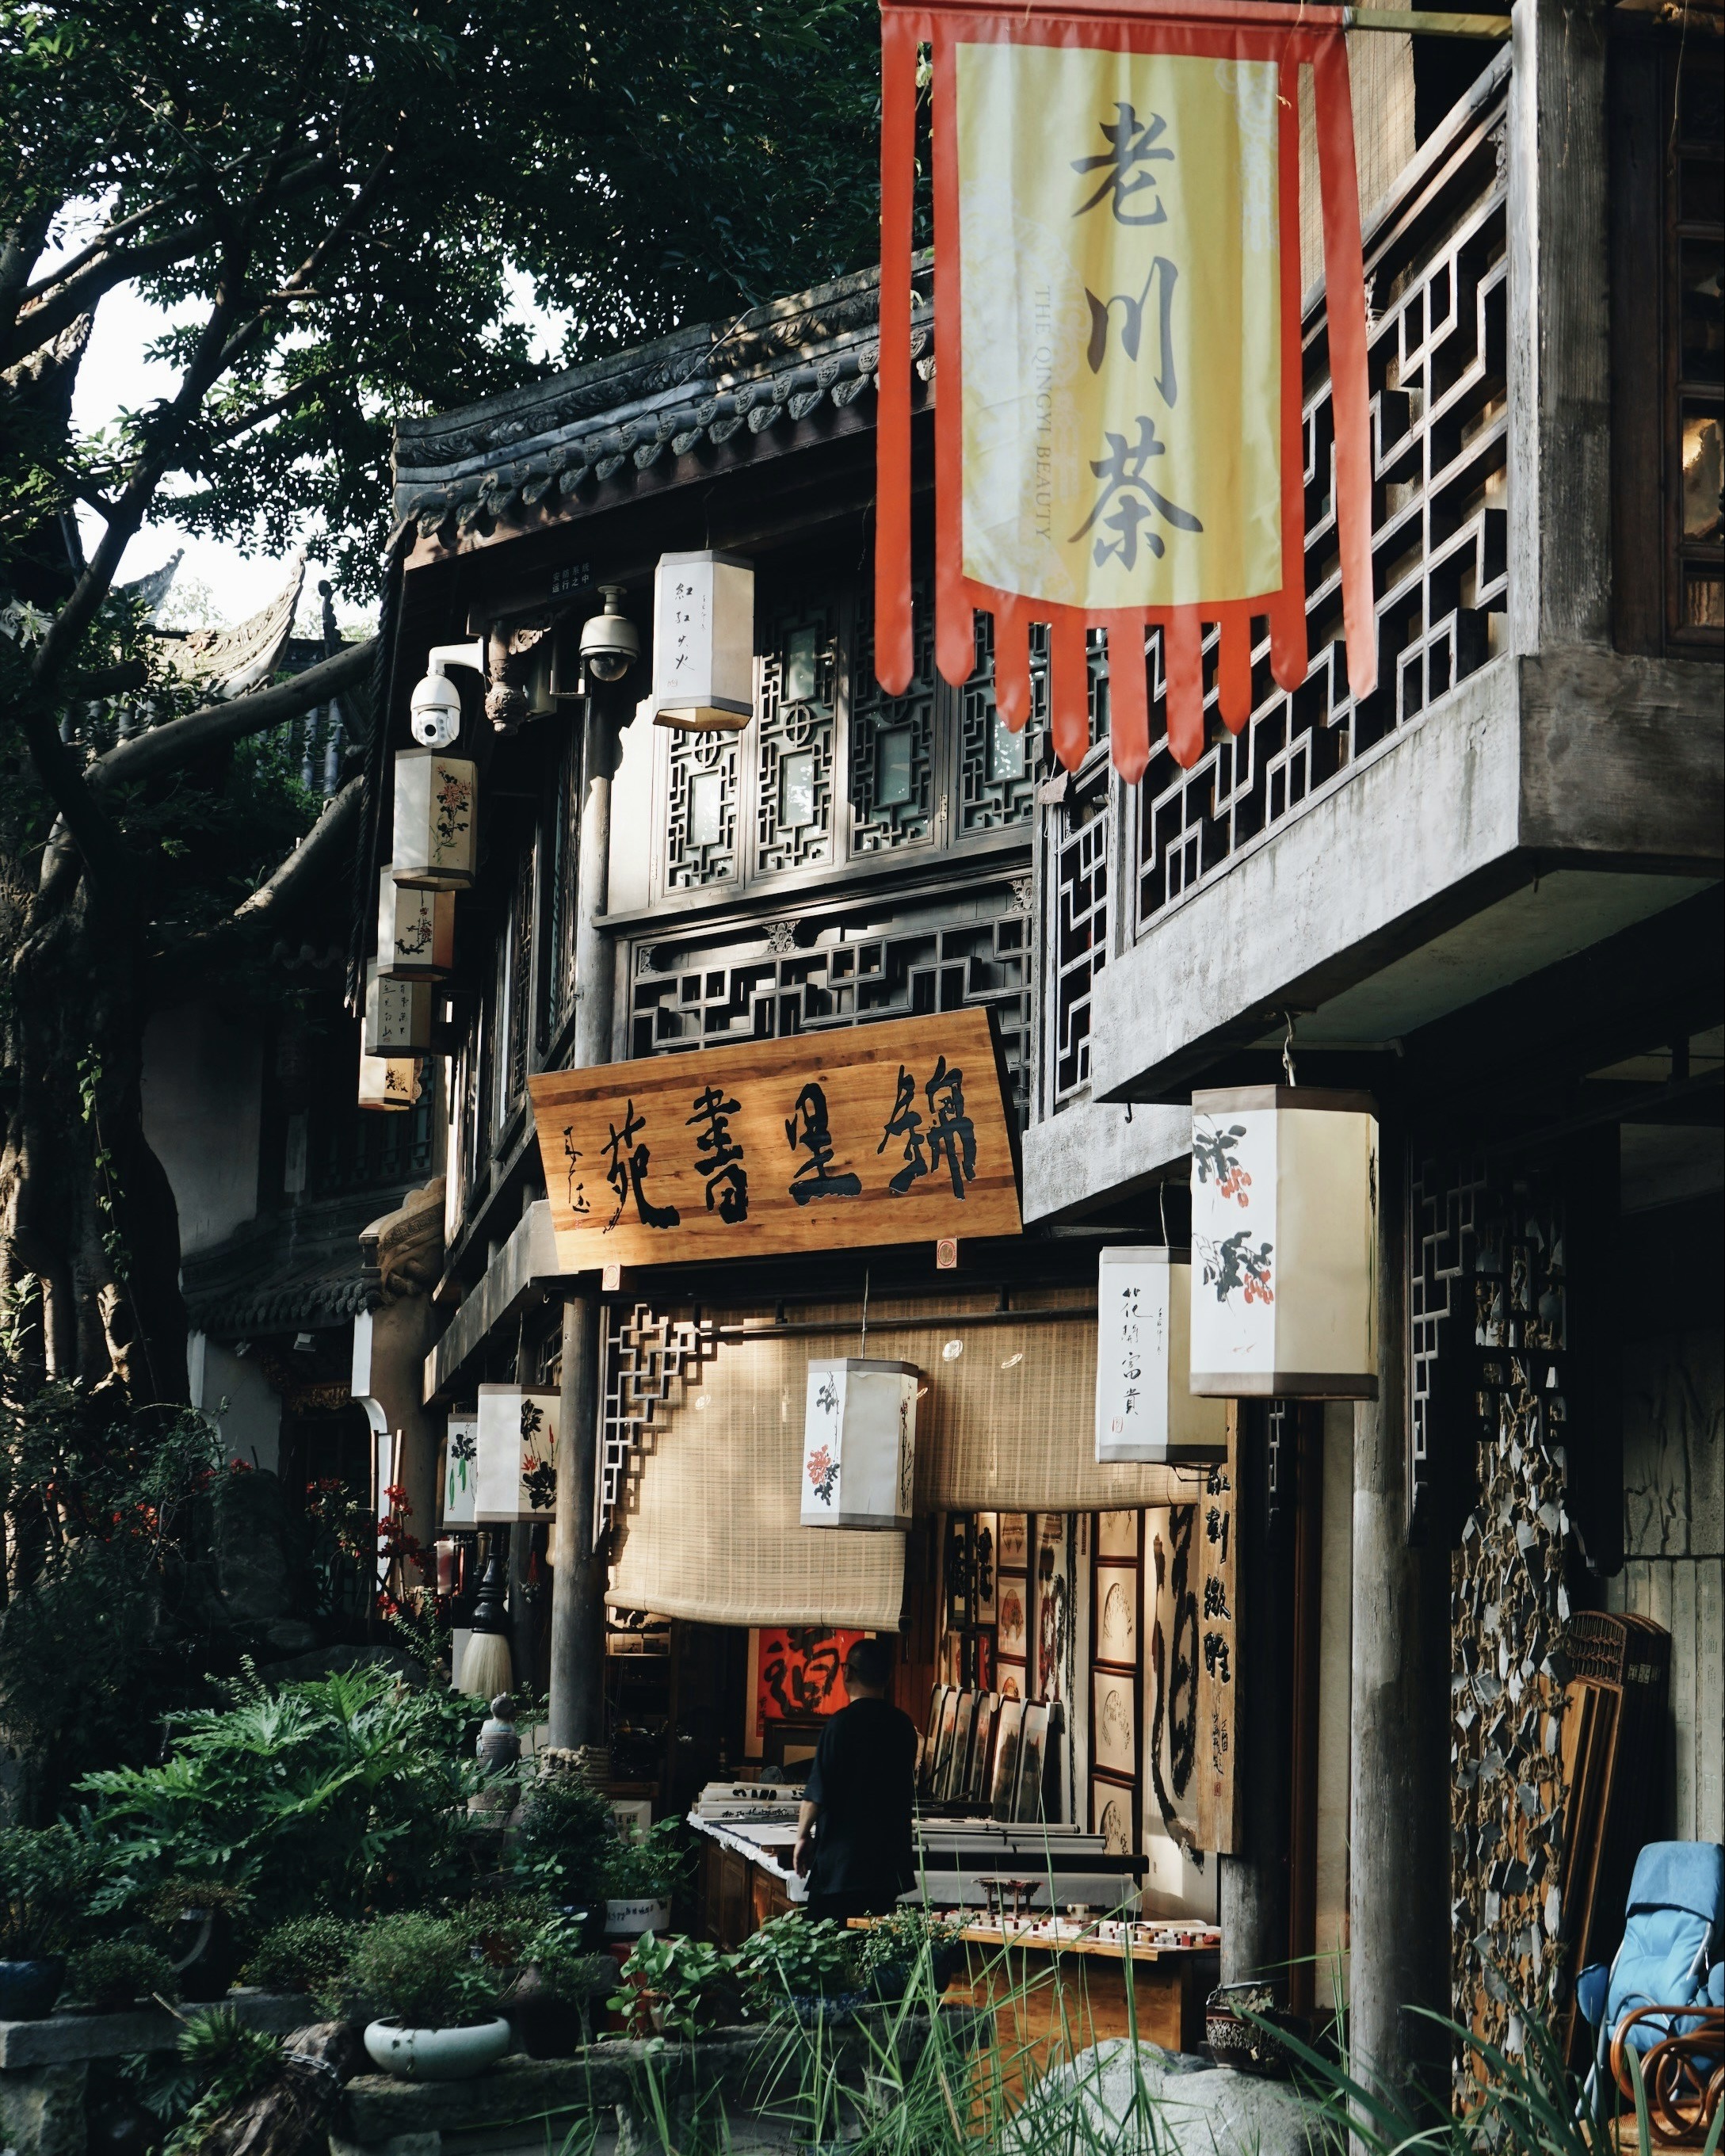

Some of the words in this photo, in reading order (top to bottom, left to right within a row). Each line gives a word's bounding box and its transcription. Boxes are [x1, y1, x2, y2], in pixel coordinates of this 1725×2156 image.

[1034, 285, 1051, 335] THE
[1068, 101, 1204, 571] 老川茶
[1032, 346, 1052, 433] QINGYI
[1035, 445, 1051, 540] BEAUTY
[551, 574, 590, 593] 运行之中
